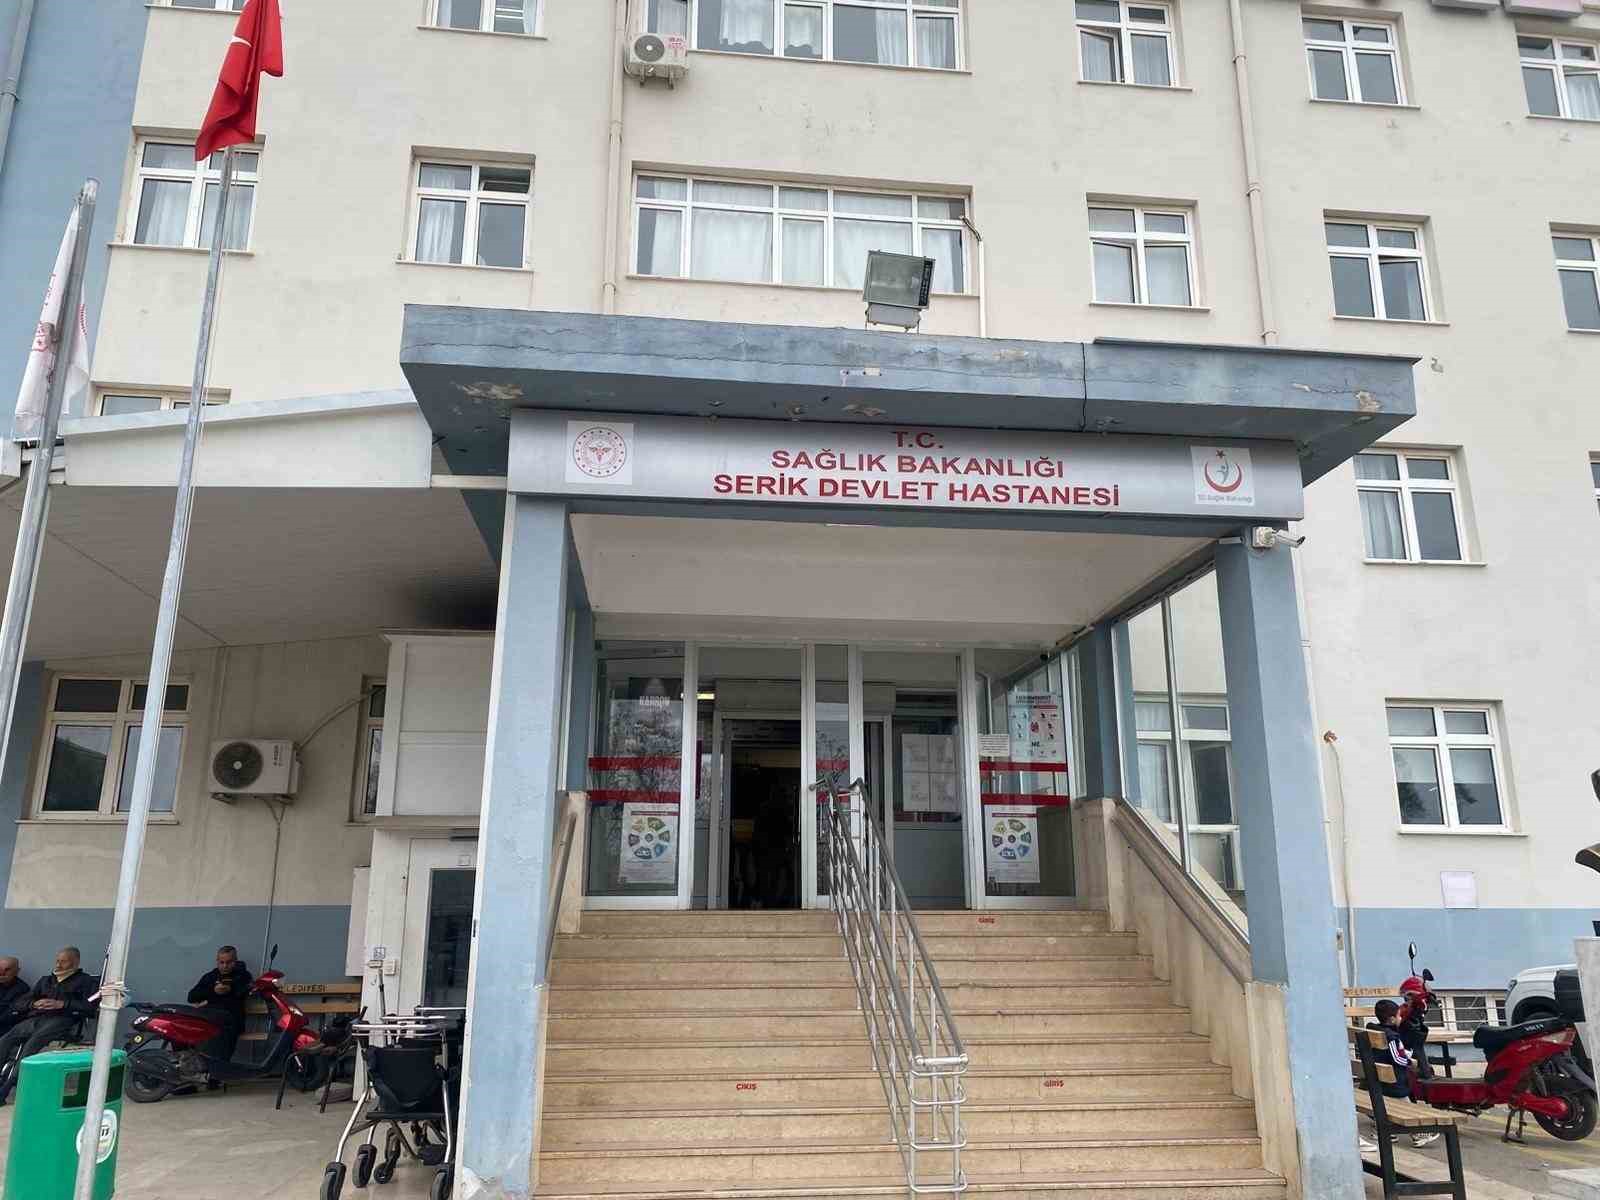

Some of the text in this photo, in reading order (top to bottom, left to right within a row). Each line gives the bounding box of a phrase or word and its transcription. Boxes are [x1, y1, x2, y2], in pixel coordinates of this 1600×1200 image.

[891, 431, 945, 449] T.C.
[771, 448, 1064, 478] SAĞLIK BAKANLIĞI
[713, 473, 1120, 507] SERİK DEVLET HASTANESİ
